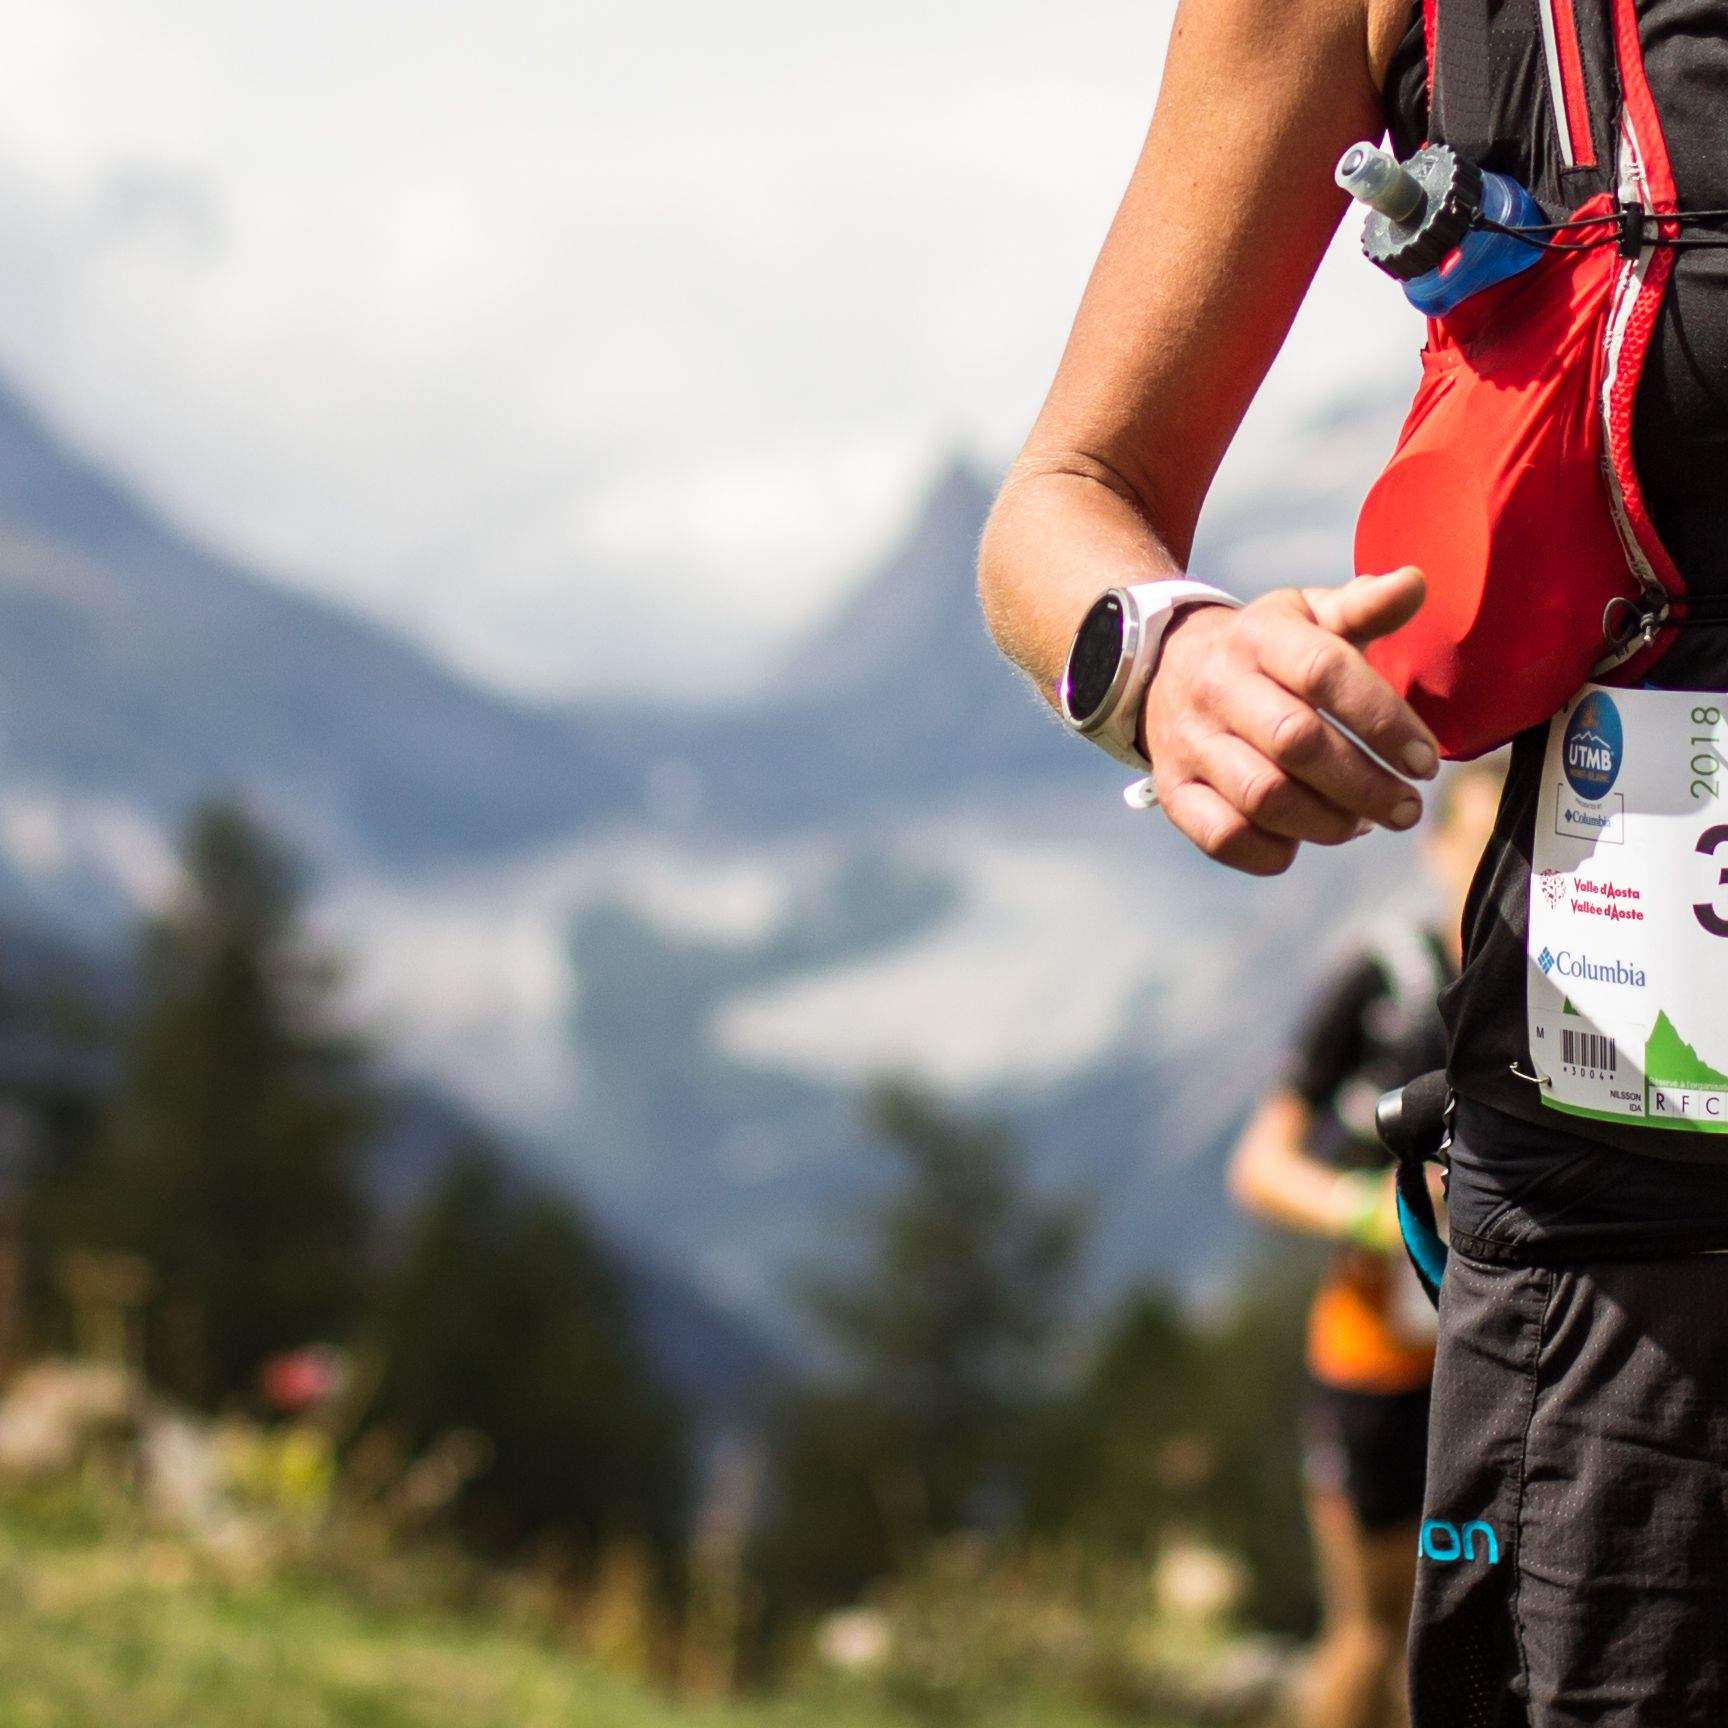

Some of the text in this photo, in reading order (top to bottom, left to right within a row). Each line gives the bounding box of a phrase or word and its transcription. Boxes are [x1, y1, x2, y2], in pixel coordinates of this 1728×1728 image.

[1569, 745, 1612, 771] UTMB
[1690, 706, 1720, 799] 2018
[1556, 951, 1647, 987] Columbia
[1536, 1026, 1545, 1039] M
[1610, 1089, 1642, 1102] NILSSON
[1656, 1092, 1665, 1111] R
[1681, 1095, 1690, 1113] F
[1705, 1097, 1720, 1115] C
[1629, 1103, 1642, 1112] IDA
